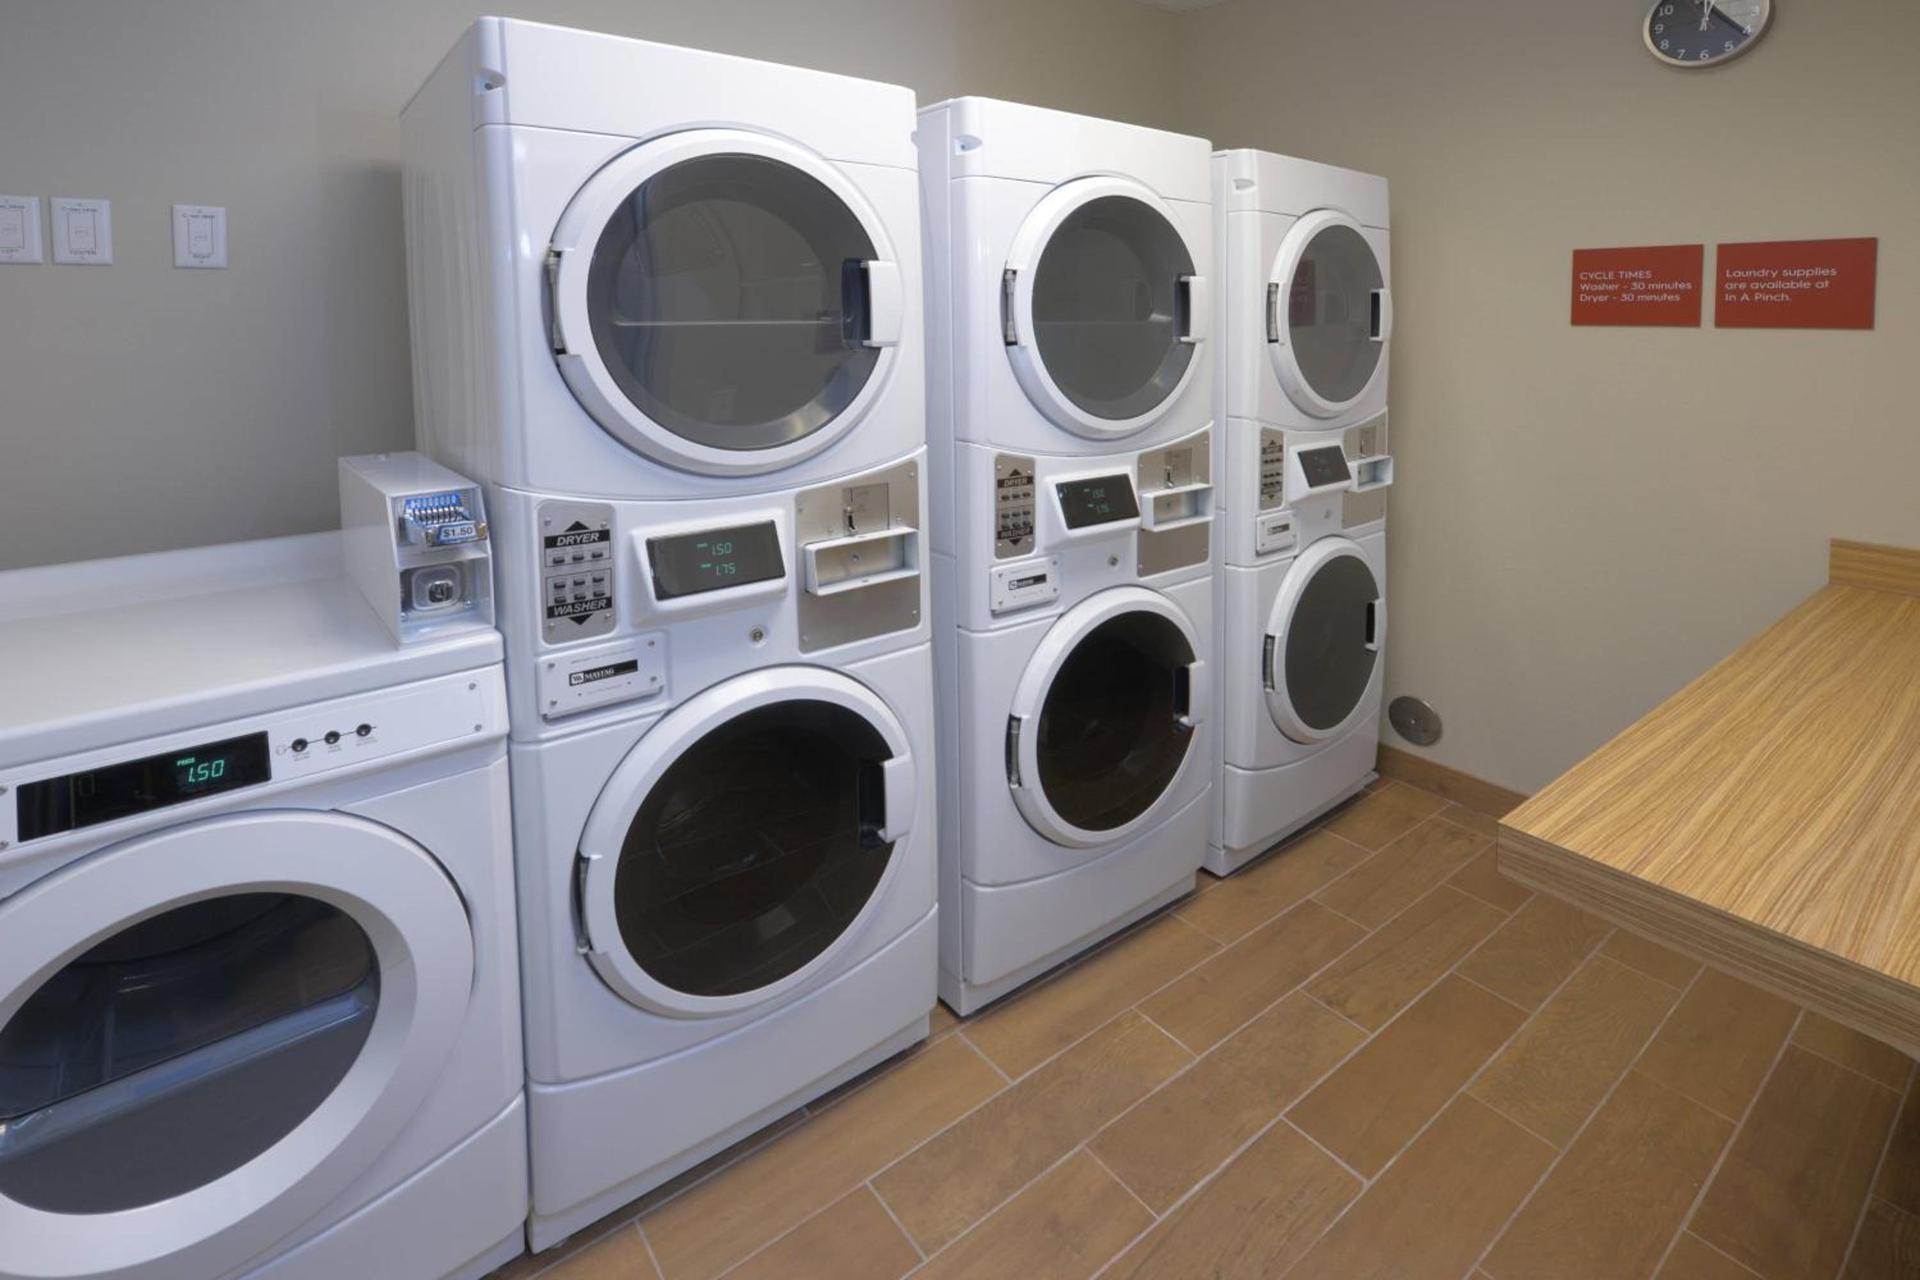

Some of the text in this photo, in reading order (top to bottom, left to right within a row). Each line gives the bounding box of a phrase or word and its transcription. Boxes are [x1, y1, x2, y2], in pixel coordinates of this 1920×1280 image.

[1659, 4, 1674, 16] 10
[1655, 23, 1664, 34] 9
[1660, 39, 1670, 50] 8
[1724, 40, 1734, 52] 5
[1677, 48, 1686, 59] 7
[1699, 49, 1710, 61] 6
[1580, 270, 1653, 280] CYCLE TIMES
[1725, 267, 1838, 278] Laundry supplies
[1580, 283, 1619, 291] Washer
[1630, 281, 1646, 290] 30
[1648, 280, 1693, 290] minutes
[1724, 279, 1830, 290] are available at
[1580, 293, 1609, 303] Dryer
[1620, 293, 1635, 302] 30
[1637, 292, 1681, 302] minutes
[1724, 292, 1792, 302] In A Pinch.
[556, 532, 600, 546] DRYER
[553, 600, 607, 616] WASHER
[188, 759, 225, 782] 1.50
